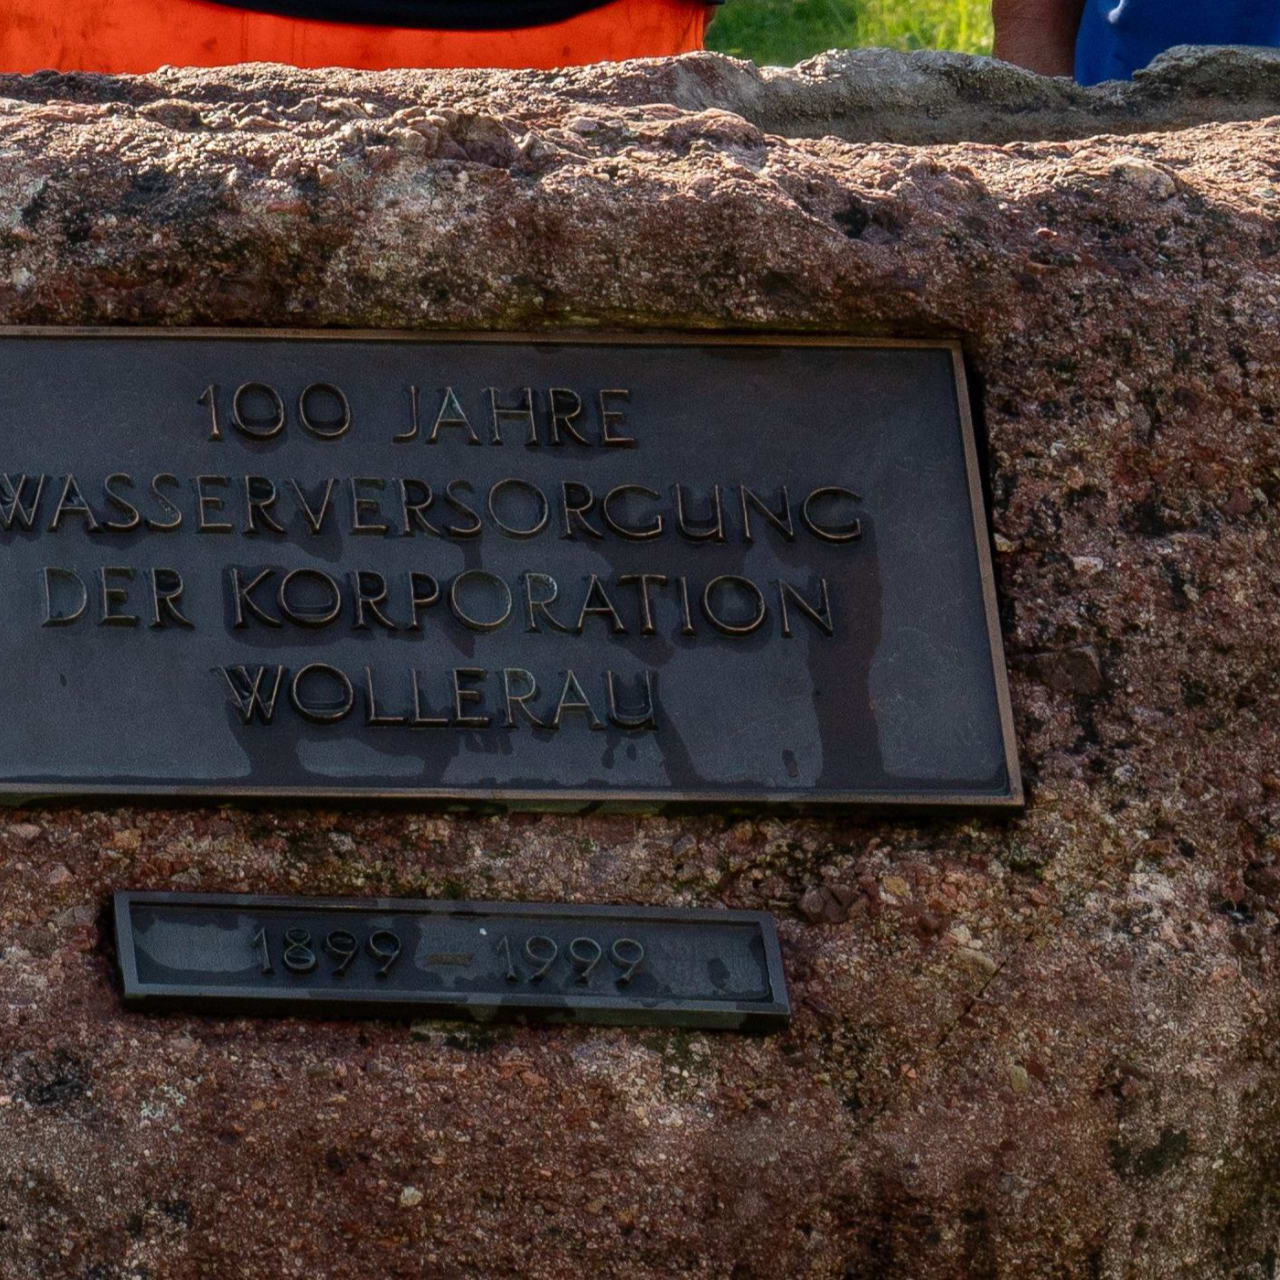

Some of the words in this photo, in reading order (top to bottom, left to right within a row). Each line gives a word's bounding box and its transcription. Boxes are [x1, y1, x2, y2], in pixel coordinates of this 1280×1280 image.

[196, 381, 352, 441] 100
[393, 385, 637, 447] JAHRE
[41, 566, 195, 628] DER
[230, 567, 834, 637] KORPORATION
[213, 662, 659, 730] WOLLERAU
[252, 926, 403, 977] 1899
[495, 935, 645, 985] 1999
